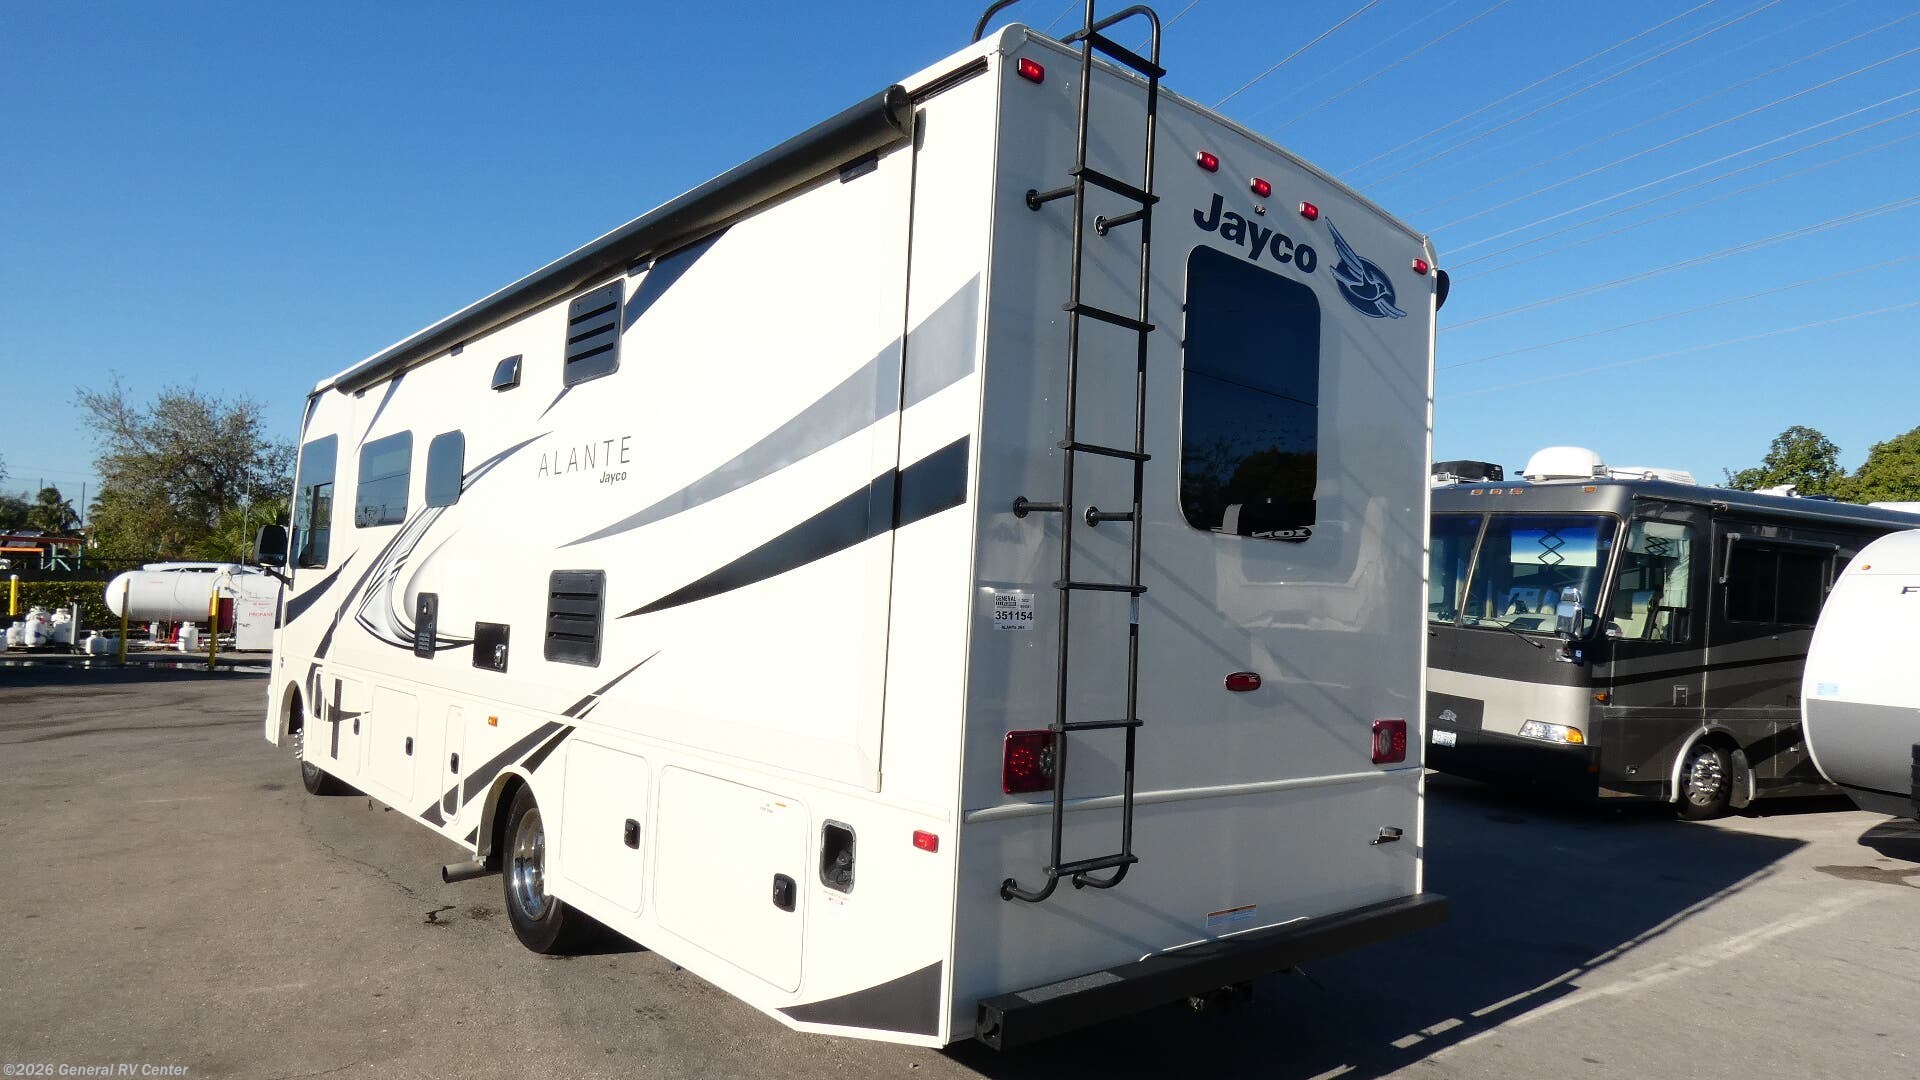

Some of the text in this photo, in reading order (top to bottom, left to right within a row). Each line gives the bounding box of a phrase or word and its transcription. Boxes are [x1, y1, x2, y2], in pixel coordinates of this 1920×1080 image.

[1193, 193, 1318, 273] Jayco
[538, 435, 631, 478] ALANTE
[599, 471, 627, 485] Jayco
[995, 610, 1033, 620] 351154
